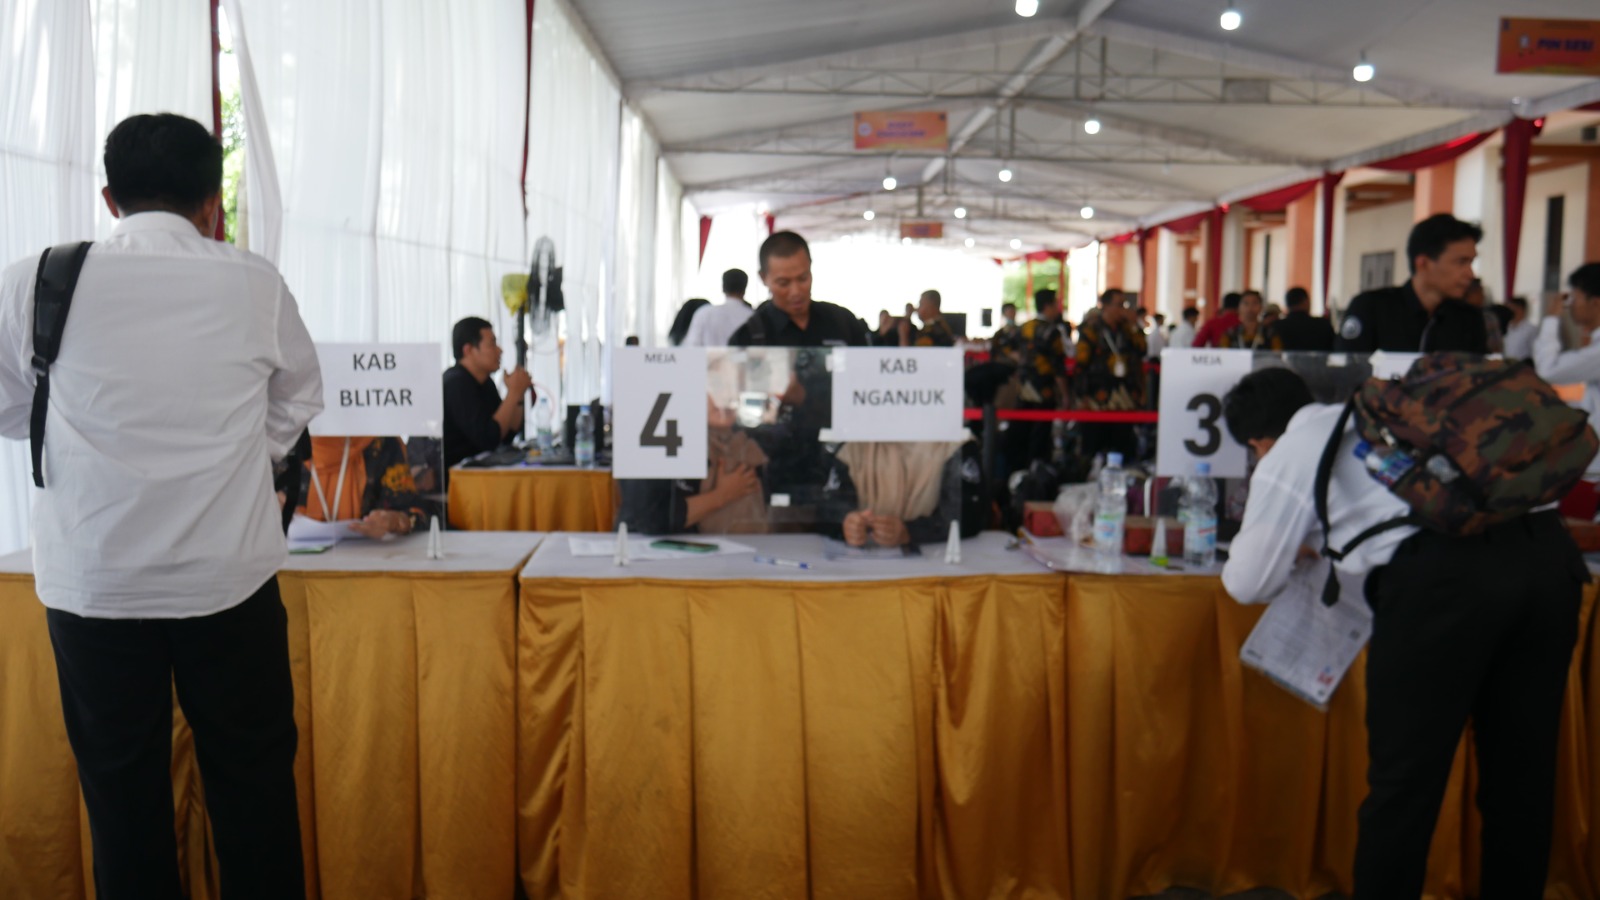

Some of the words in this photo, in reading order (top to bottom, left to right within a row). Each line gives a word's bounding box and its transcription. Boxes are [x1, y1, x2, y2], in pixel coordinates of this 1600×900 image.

[353, 353, 397, 371] KAB
[645, 353, 677, 364] MEJA
[880, 358, 918, 374] KAB
[1192, 355, 1222, 366] MEJA
[340, 389, 413, 407] BLITAR
[853, 390, 946, 406] NGANJUK
[639, 392, 683, 458] 4
[1183, 393, 1222, 457] 3
